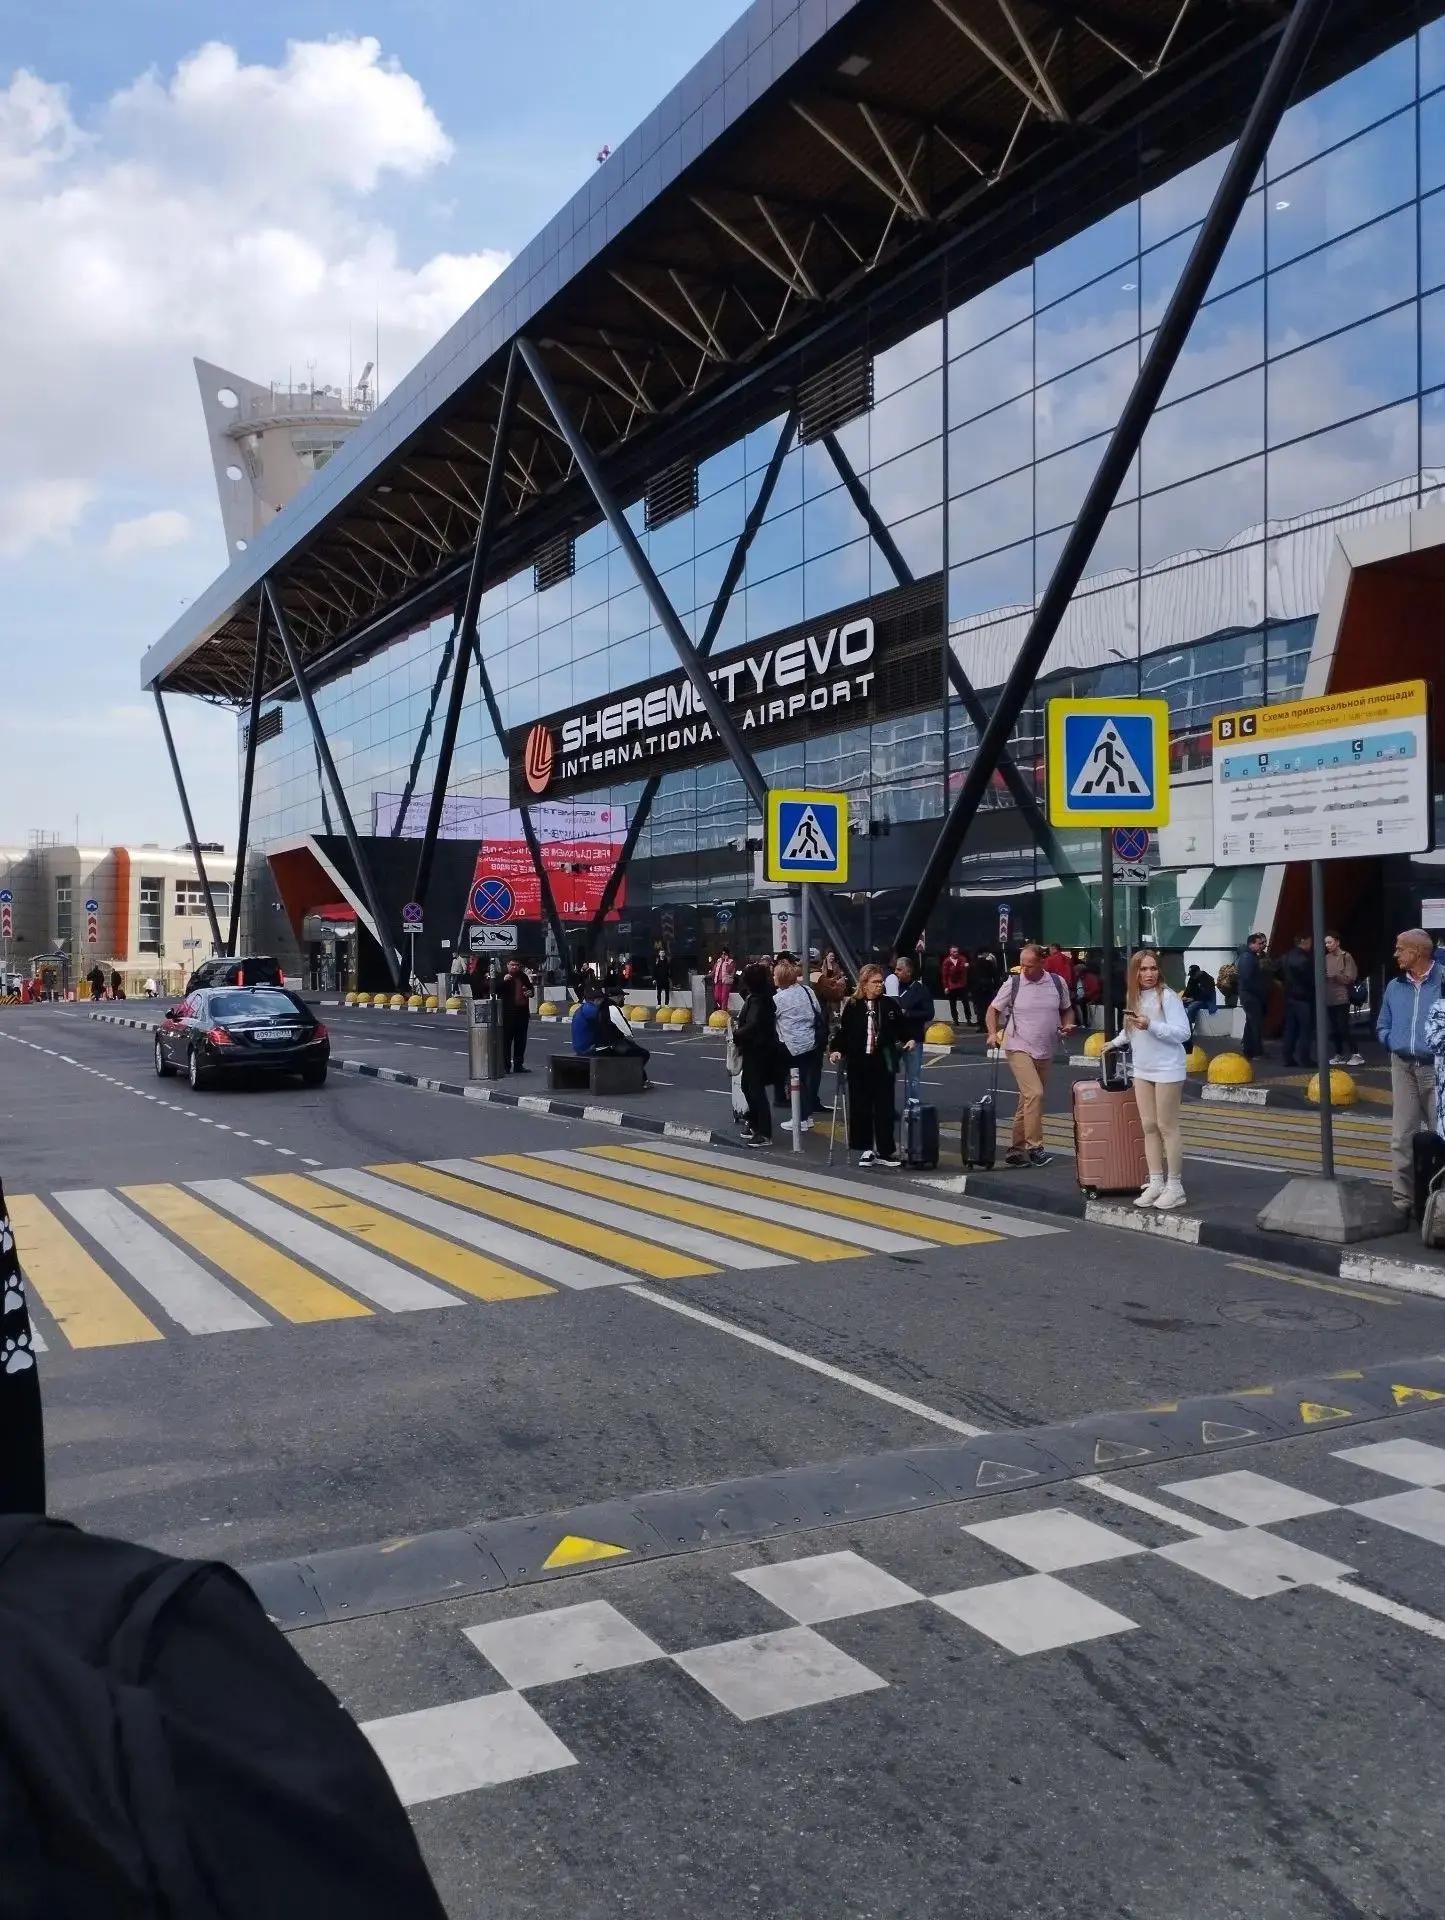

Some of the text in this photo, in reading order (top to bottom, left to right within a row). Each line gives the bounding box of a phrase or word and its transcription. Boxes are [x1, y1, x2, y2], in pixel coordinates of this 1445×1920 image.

[1262, 711, 1290, 722] Схема
[1291, 697, 1366, 718] привокзальной
[1367, 688, 1415, 706] площади
[562, 672, 875, 779] INTERNATIONA AIRPORT
[1221, 721, 1233, 737] B
[1242, 717, 1253, 734] C
